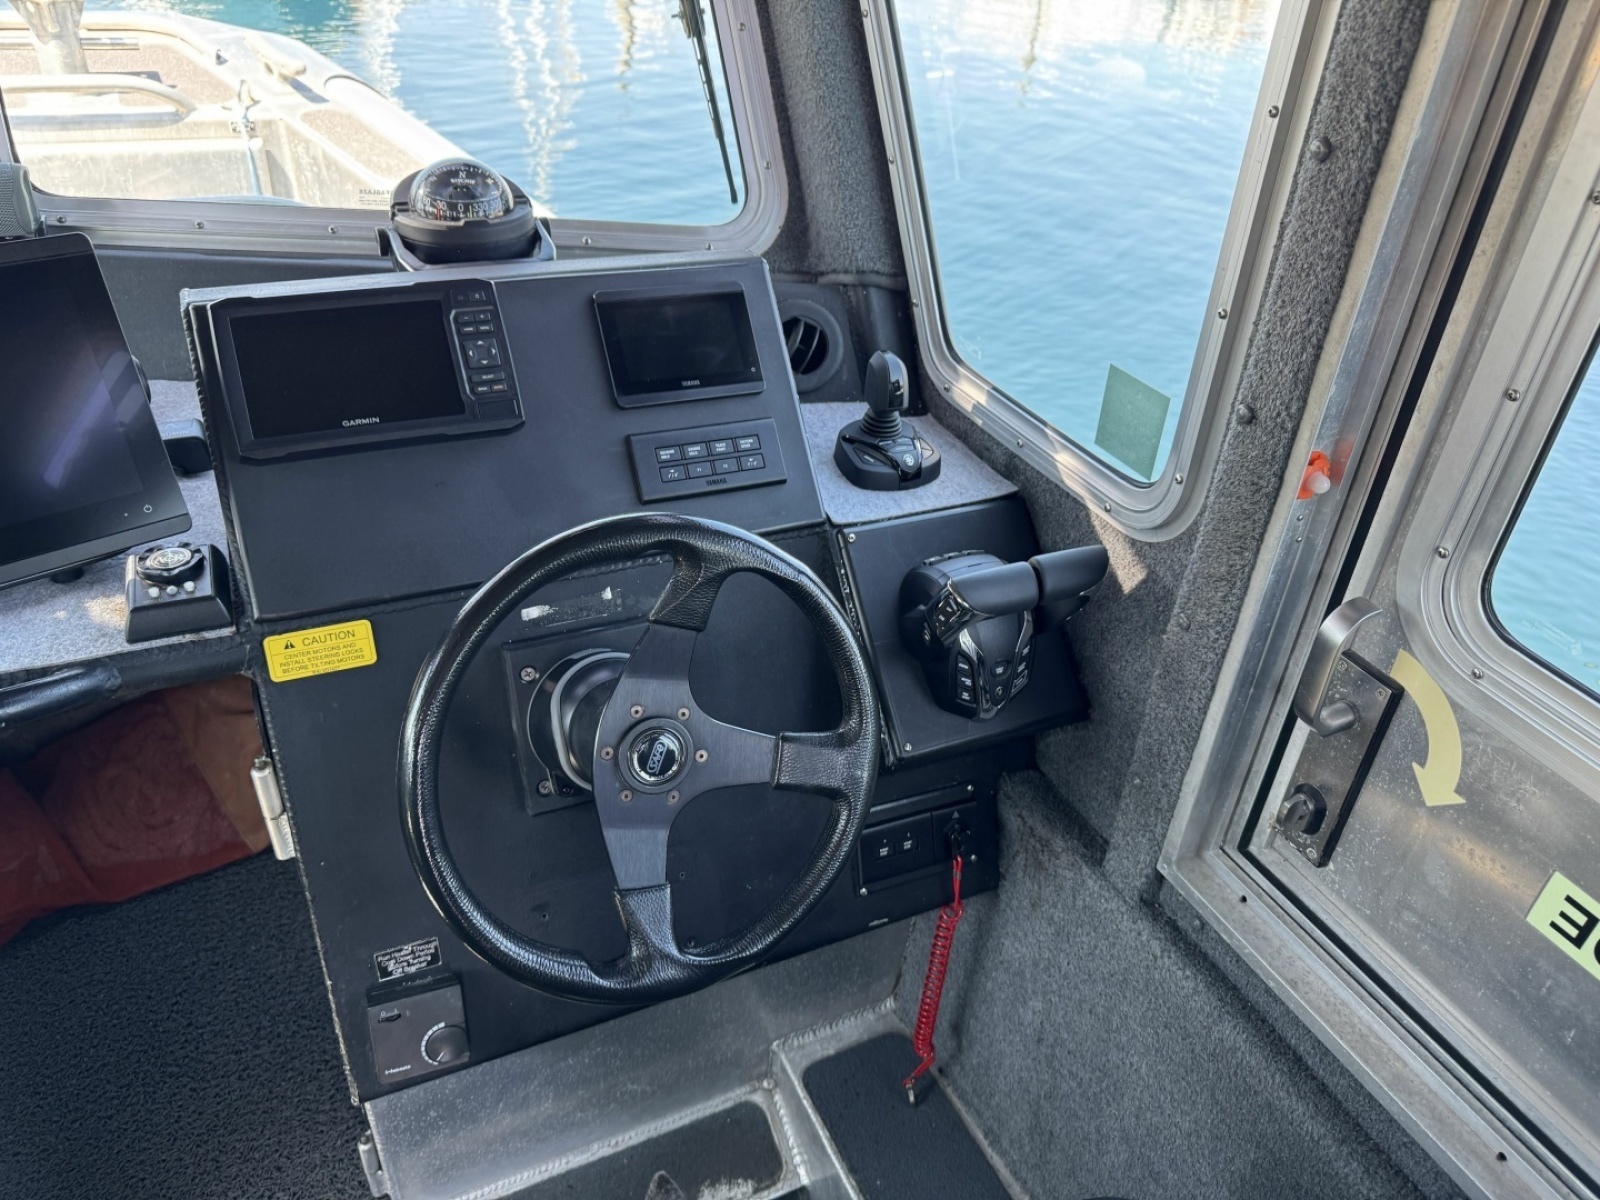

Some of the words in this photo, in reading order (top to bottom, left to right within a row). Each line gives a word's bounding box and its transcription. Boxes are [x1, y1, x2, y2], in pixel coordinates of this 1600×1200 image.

[459, 171, 467, 179] N
[458, 203, 464, 212] 0
[342, 416, 380, 427] GARMIN
[302, 629, 356, 646] CAUTION
[279, 658, 306, 668] INSTALL
[307, 652, 341, 662] STEERING
[342, 647, 364, 656] LOCKS
[284, 650, 311, 660] CENTER
[312, 645, 341, 655] MOTORS
[282, 664, 309, 674] BEFORE
[311, 659, 336, 669] TILTING
[337, 654, 365, 663] MOTORS
